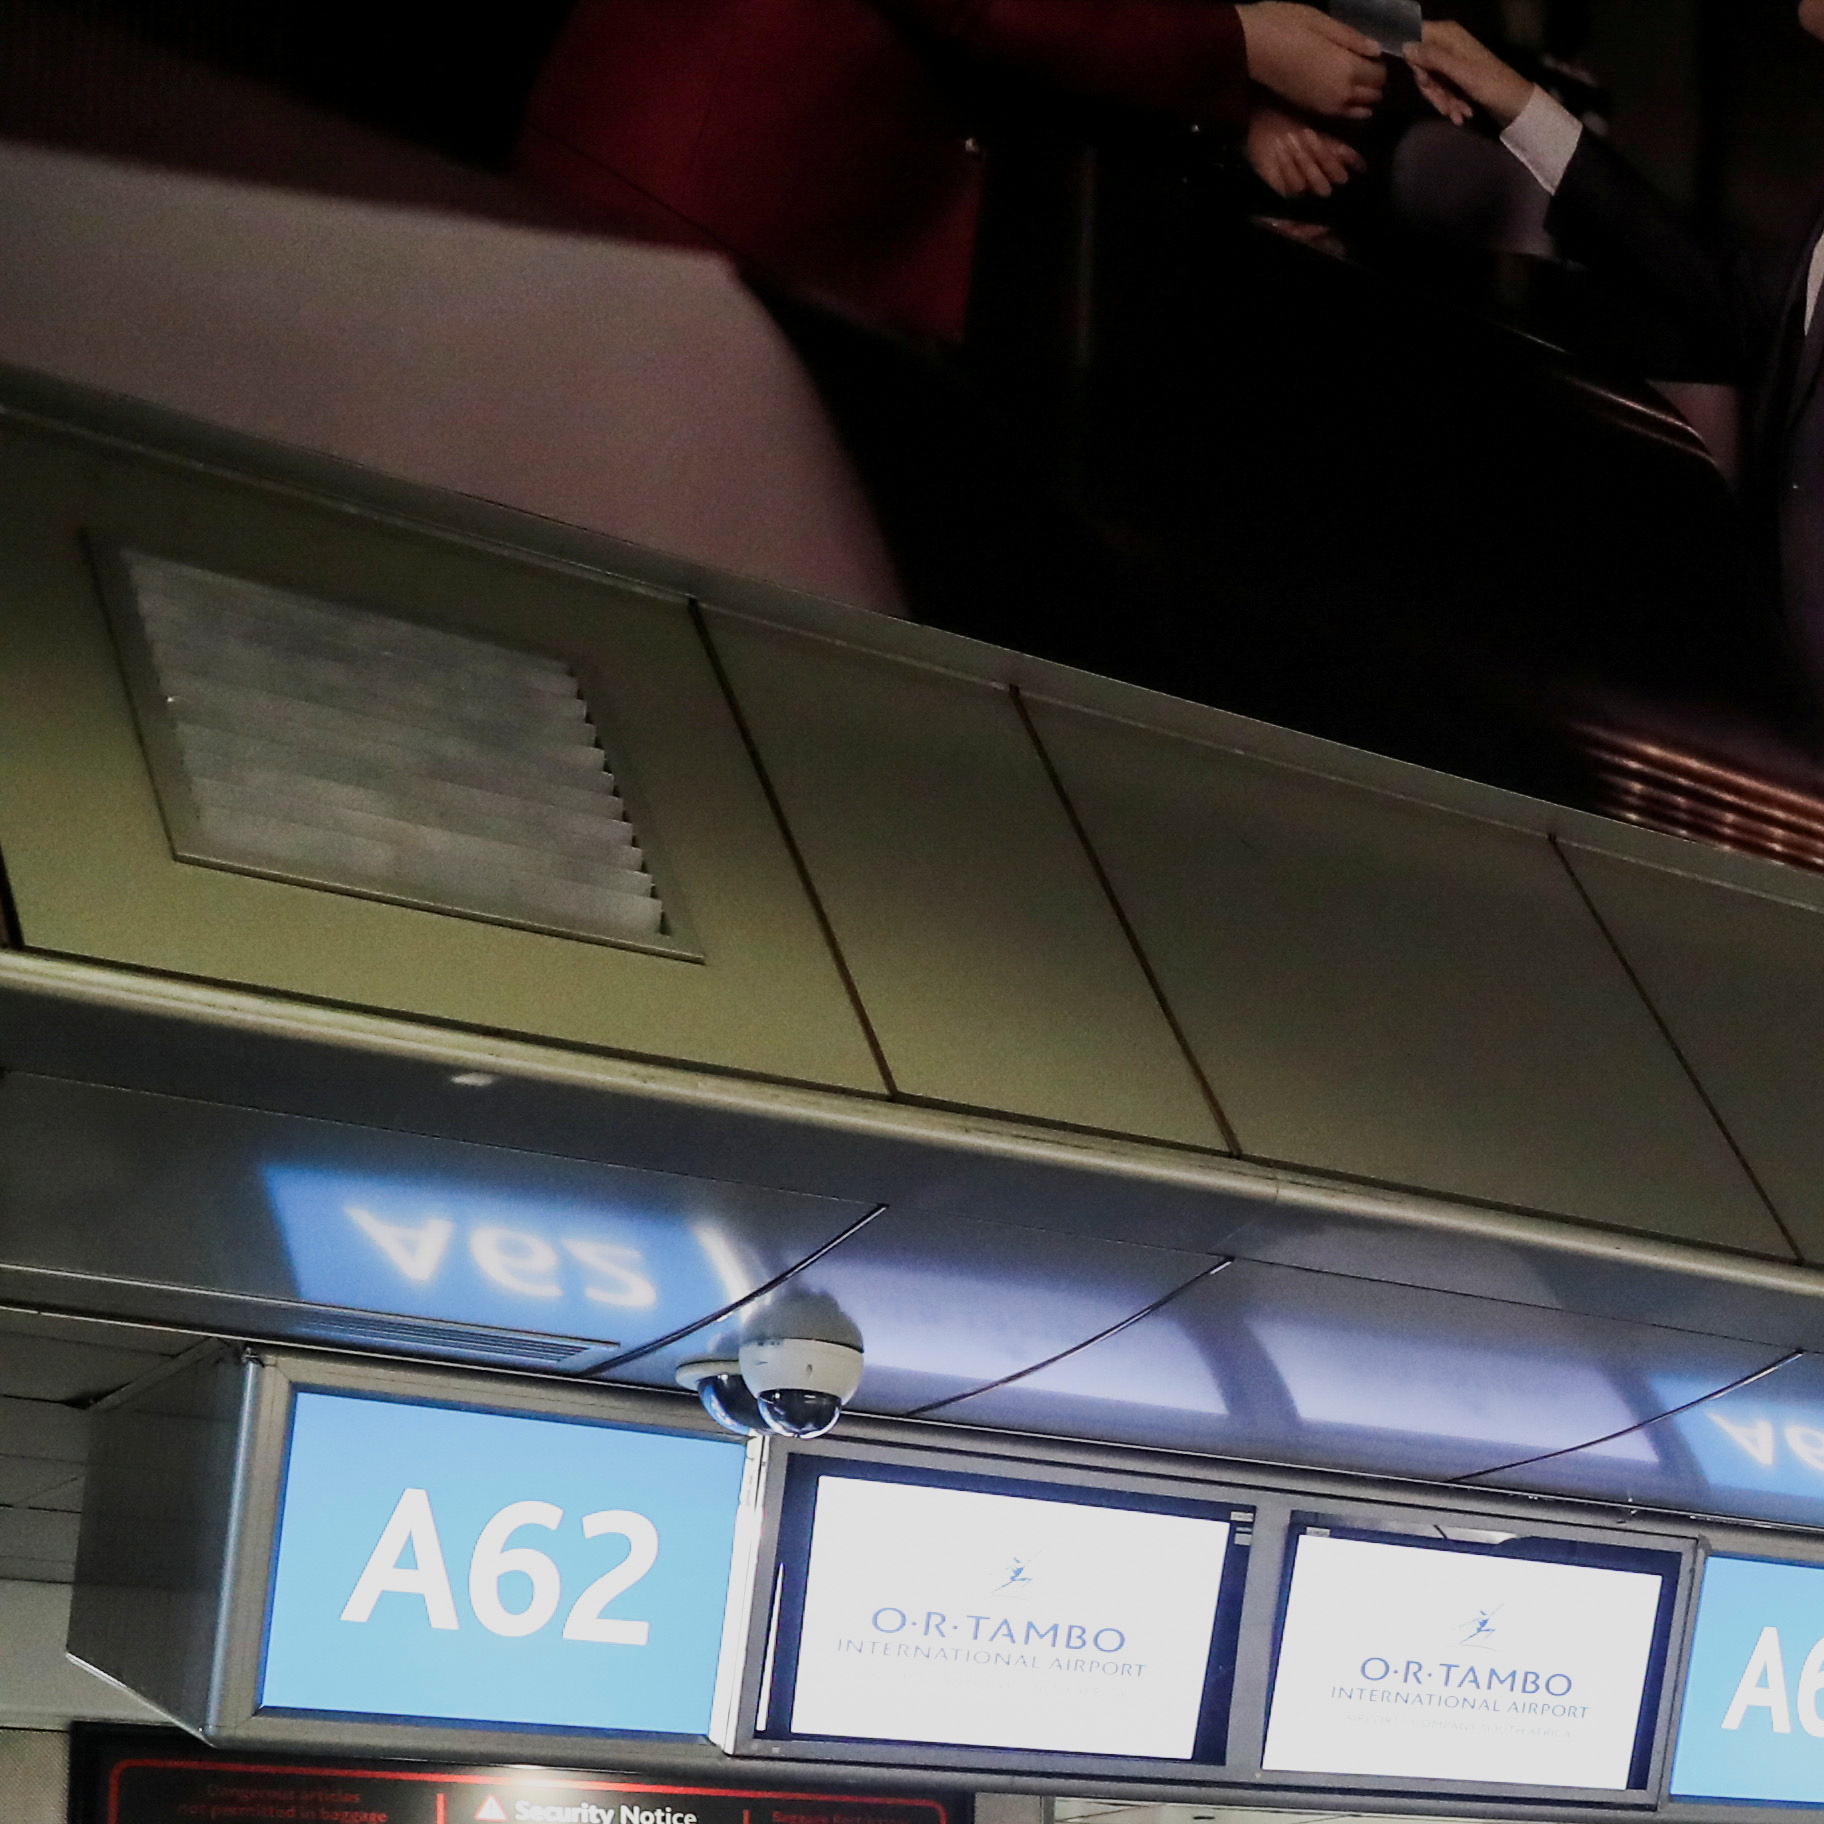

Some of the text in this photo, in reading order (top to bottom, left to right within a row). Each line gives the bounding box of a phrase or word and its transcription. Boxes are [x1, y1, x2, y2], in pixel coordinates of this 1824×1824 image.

[340, 1487, 660, 1646] A62
[837, 1639, 1147, 1678] INTERNATIONAL AIRPORT
[1331, 1686, 1590, 1719] INTERNATIONAL AIRPORT
